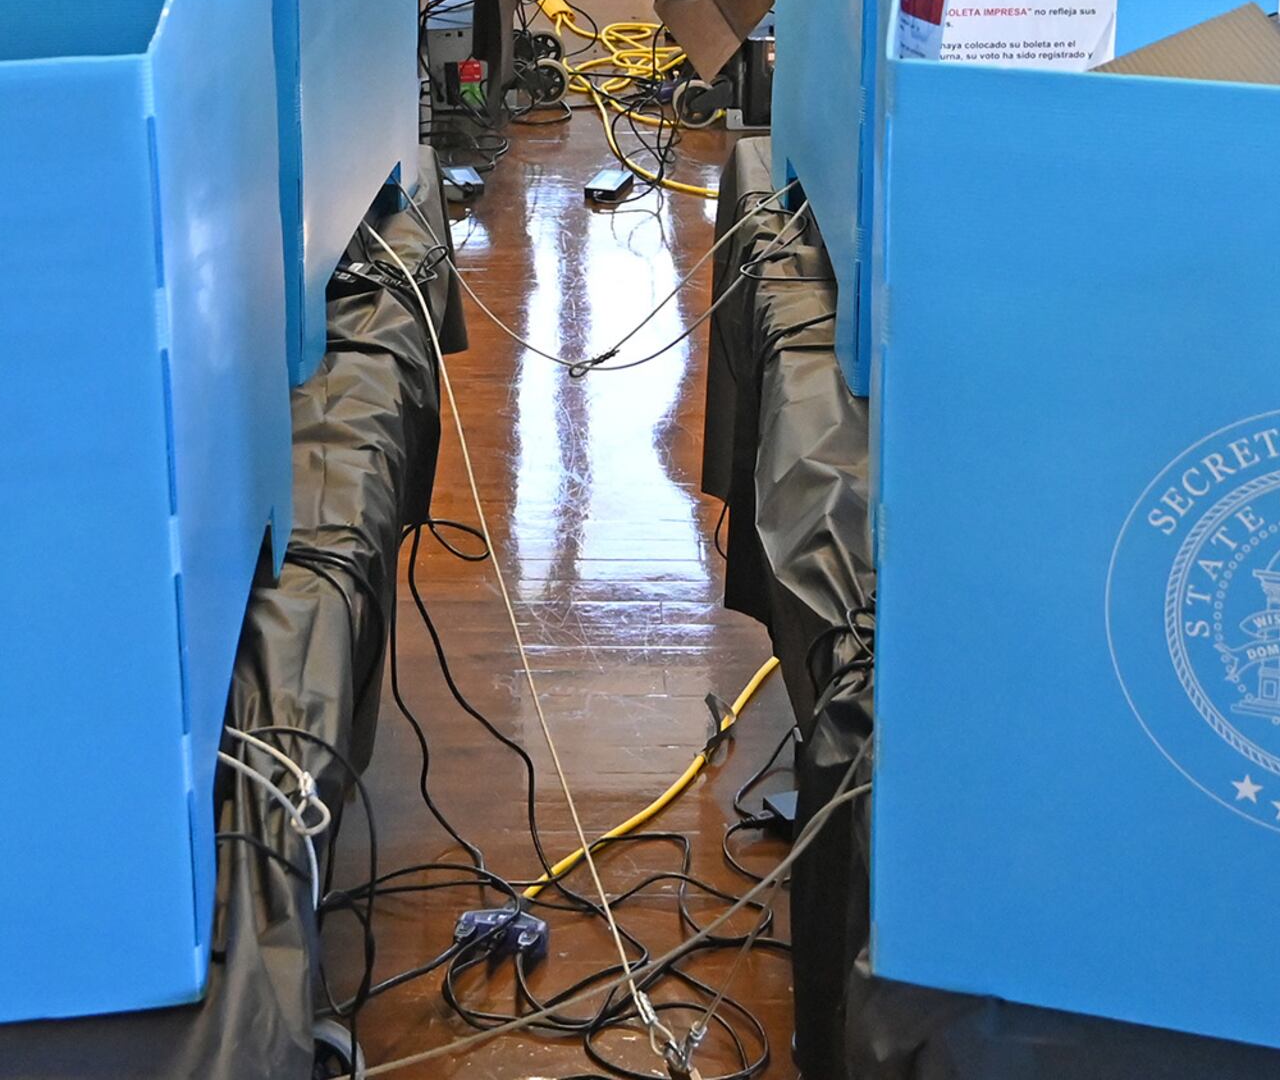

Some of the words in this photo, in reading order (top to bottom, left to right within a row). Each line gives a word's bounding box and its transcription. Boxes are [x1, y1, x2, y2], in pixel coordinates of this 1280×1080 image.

[945, 8, 981, 17] OLETA
[1048, 7, 1078, 18] refleja
[940, 42, 962, 52] haya
[964, 40, 1007, 49] colocado
[1023, 40, 1051, 48] boleta
[1067, 40, 1076, 48] el
[966, 52, 977, 60] su
[979, 51, 999, 60] voto
[1002, 51, 1013, 59] ha
[1015, 51, 1035, 59] sido
[1038, 50, 1085, 61] registrado
[1184, 505, 1266, 638] STATE
